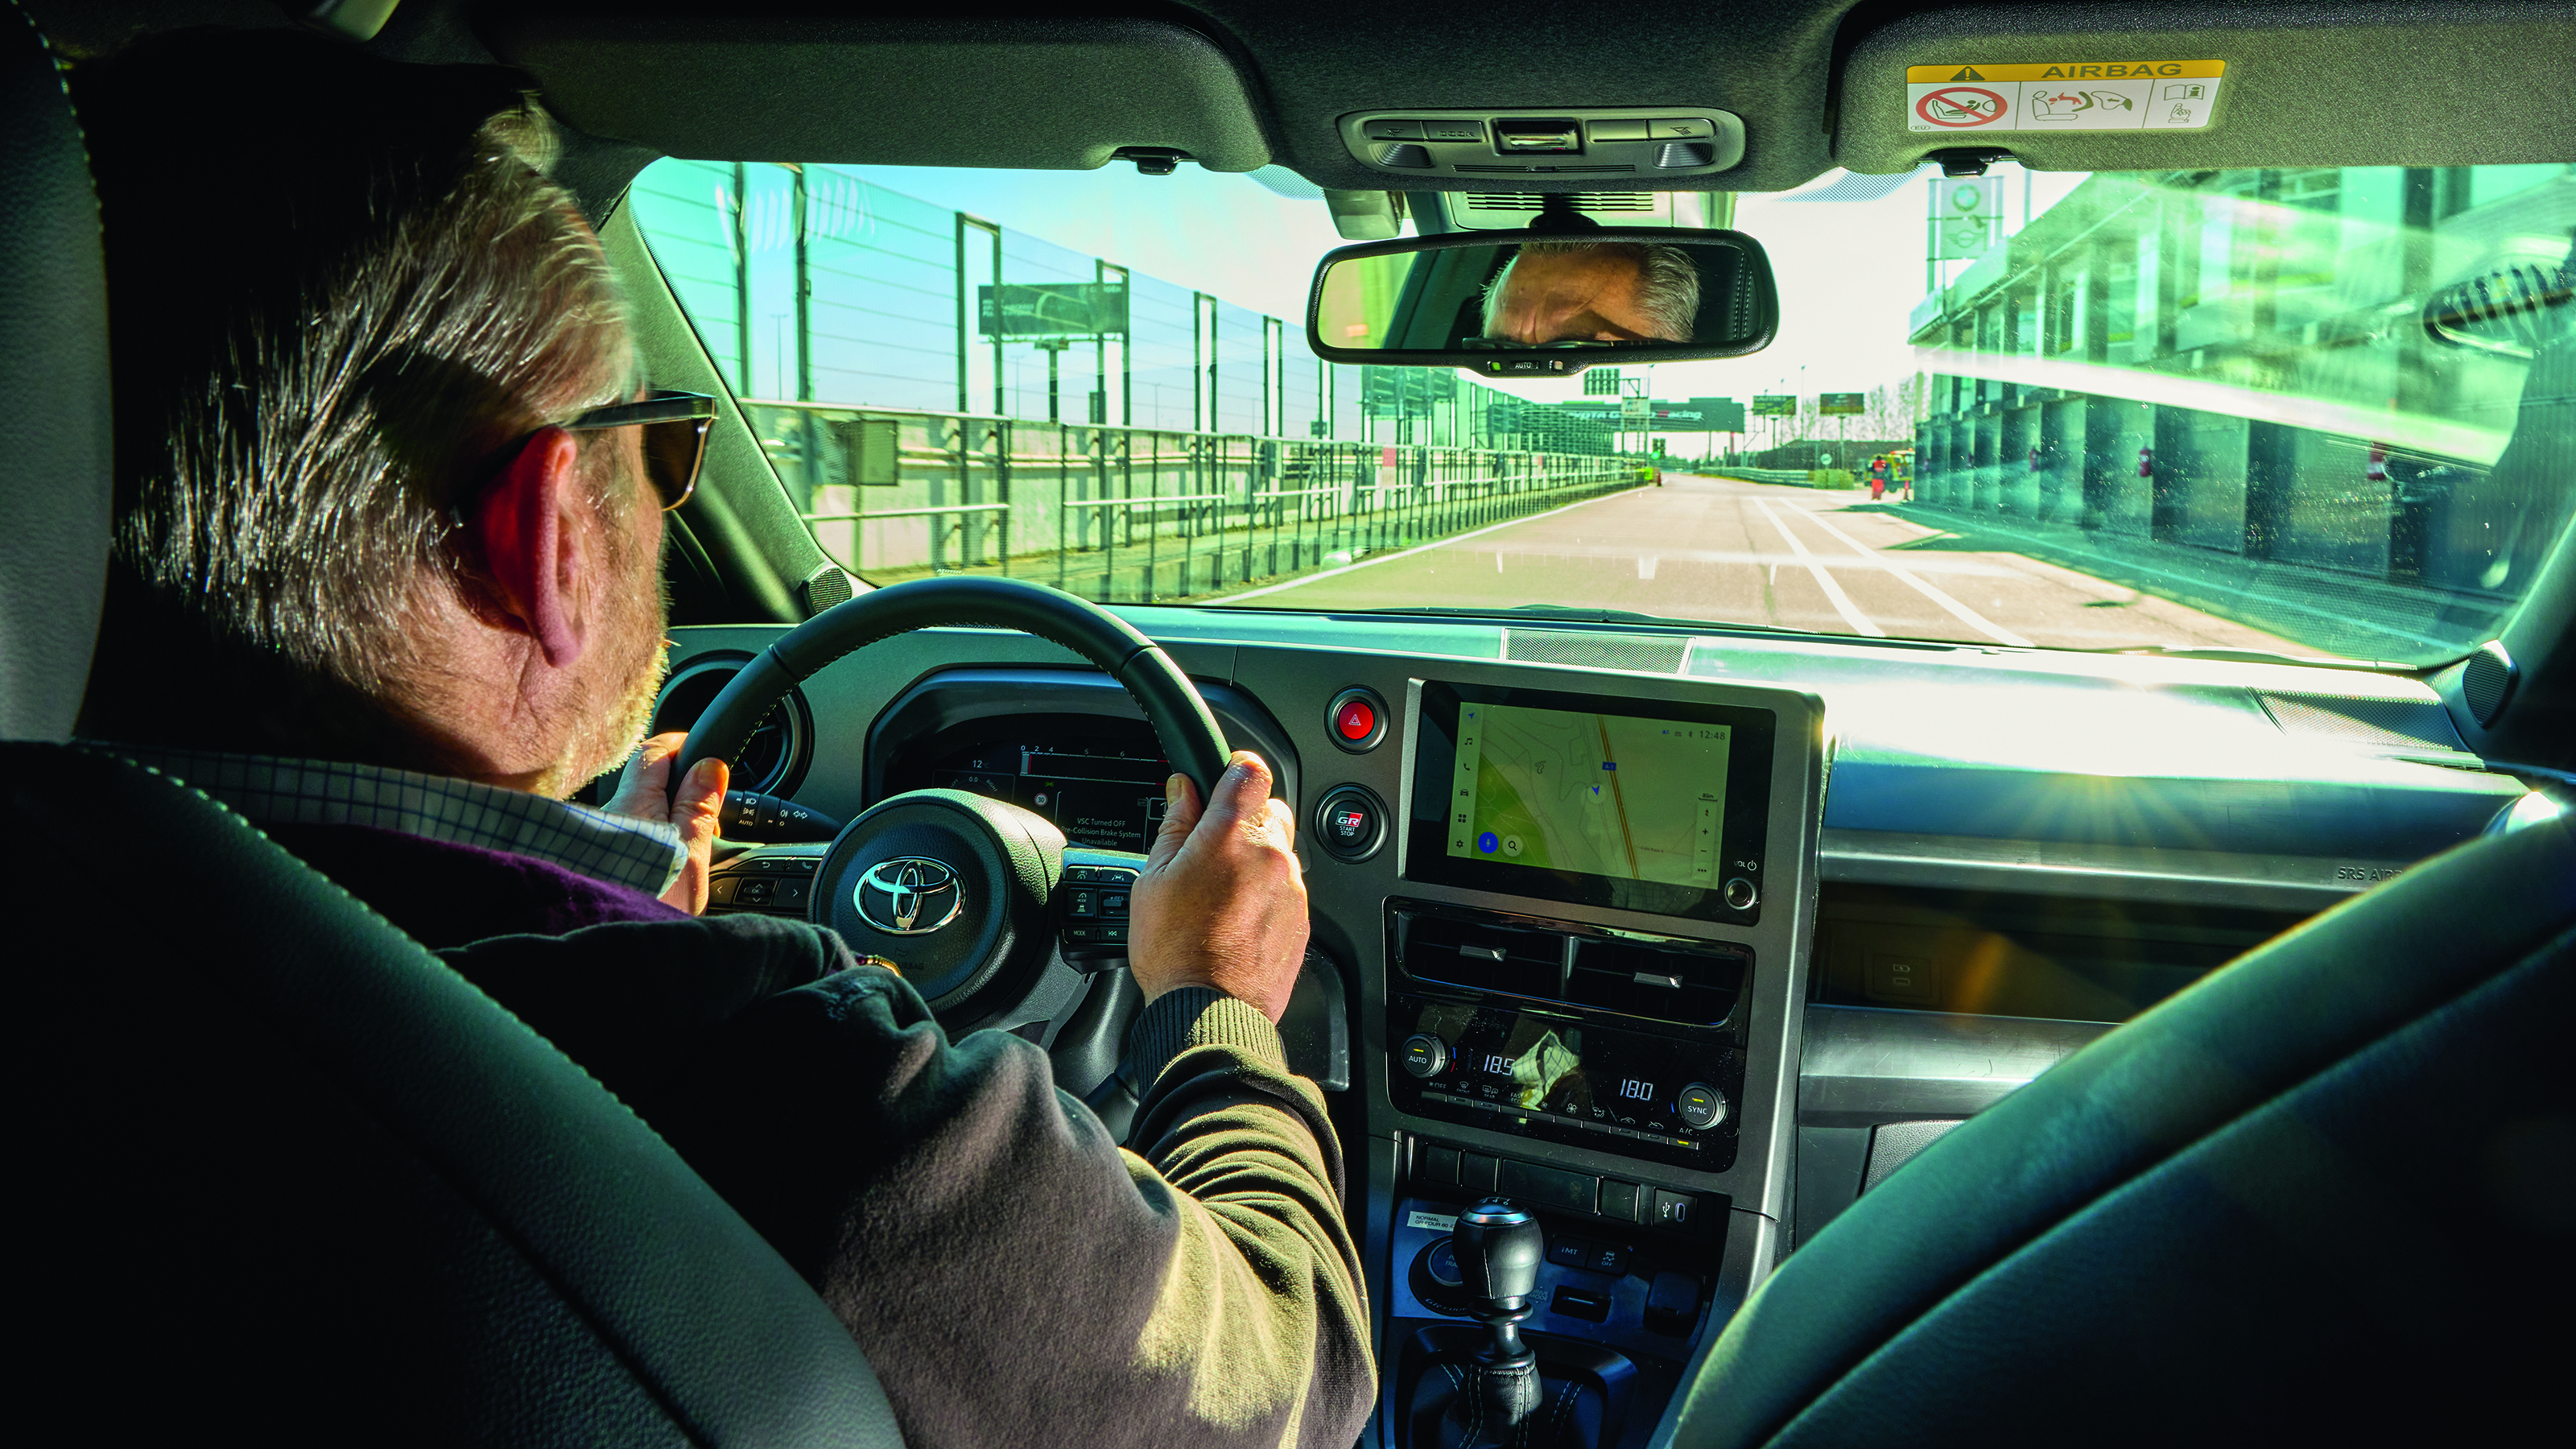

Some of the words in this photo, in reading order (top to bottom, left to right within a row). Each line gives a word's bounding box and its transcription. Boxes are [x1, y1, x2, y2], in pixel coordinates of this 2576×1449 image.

[2041, 63, 2182, 79] AIRBAG
[1514, 361, 1533, 369] AUTO
[1699, 730, 1726, 741] 12:48
[738, 819, 753, 827] AUTO
[1077, 817, 1089, 825] VSC
[1091, 818, 1113, 827] Turned
[1337, 816, 1359, 825] GR
[1061, 826, 1100, 836] Pre-Collision
[1100, 828, 1117, 837] Brake
[1118, 830, 1141, 839] System
[1081, 837, 1118, 847] Unavailable
[1733, 860, 1746, 868] VOL
[2337, 865, 2365, 881] SRS
[2369, 868, 2403, 881] AIR
[1408, 1055, 1427, 1064] AUTO
[1483, 1054, 1516, 1076] 18.5
[1620, 1078, 1653, 1101] 18.0
[1687, 1105, 1707, 1115] SYNC
[1678, 1127, 1694, 1136] A/C
